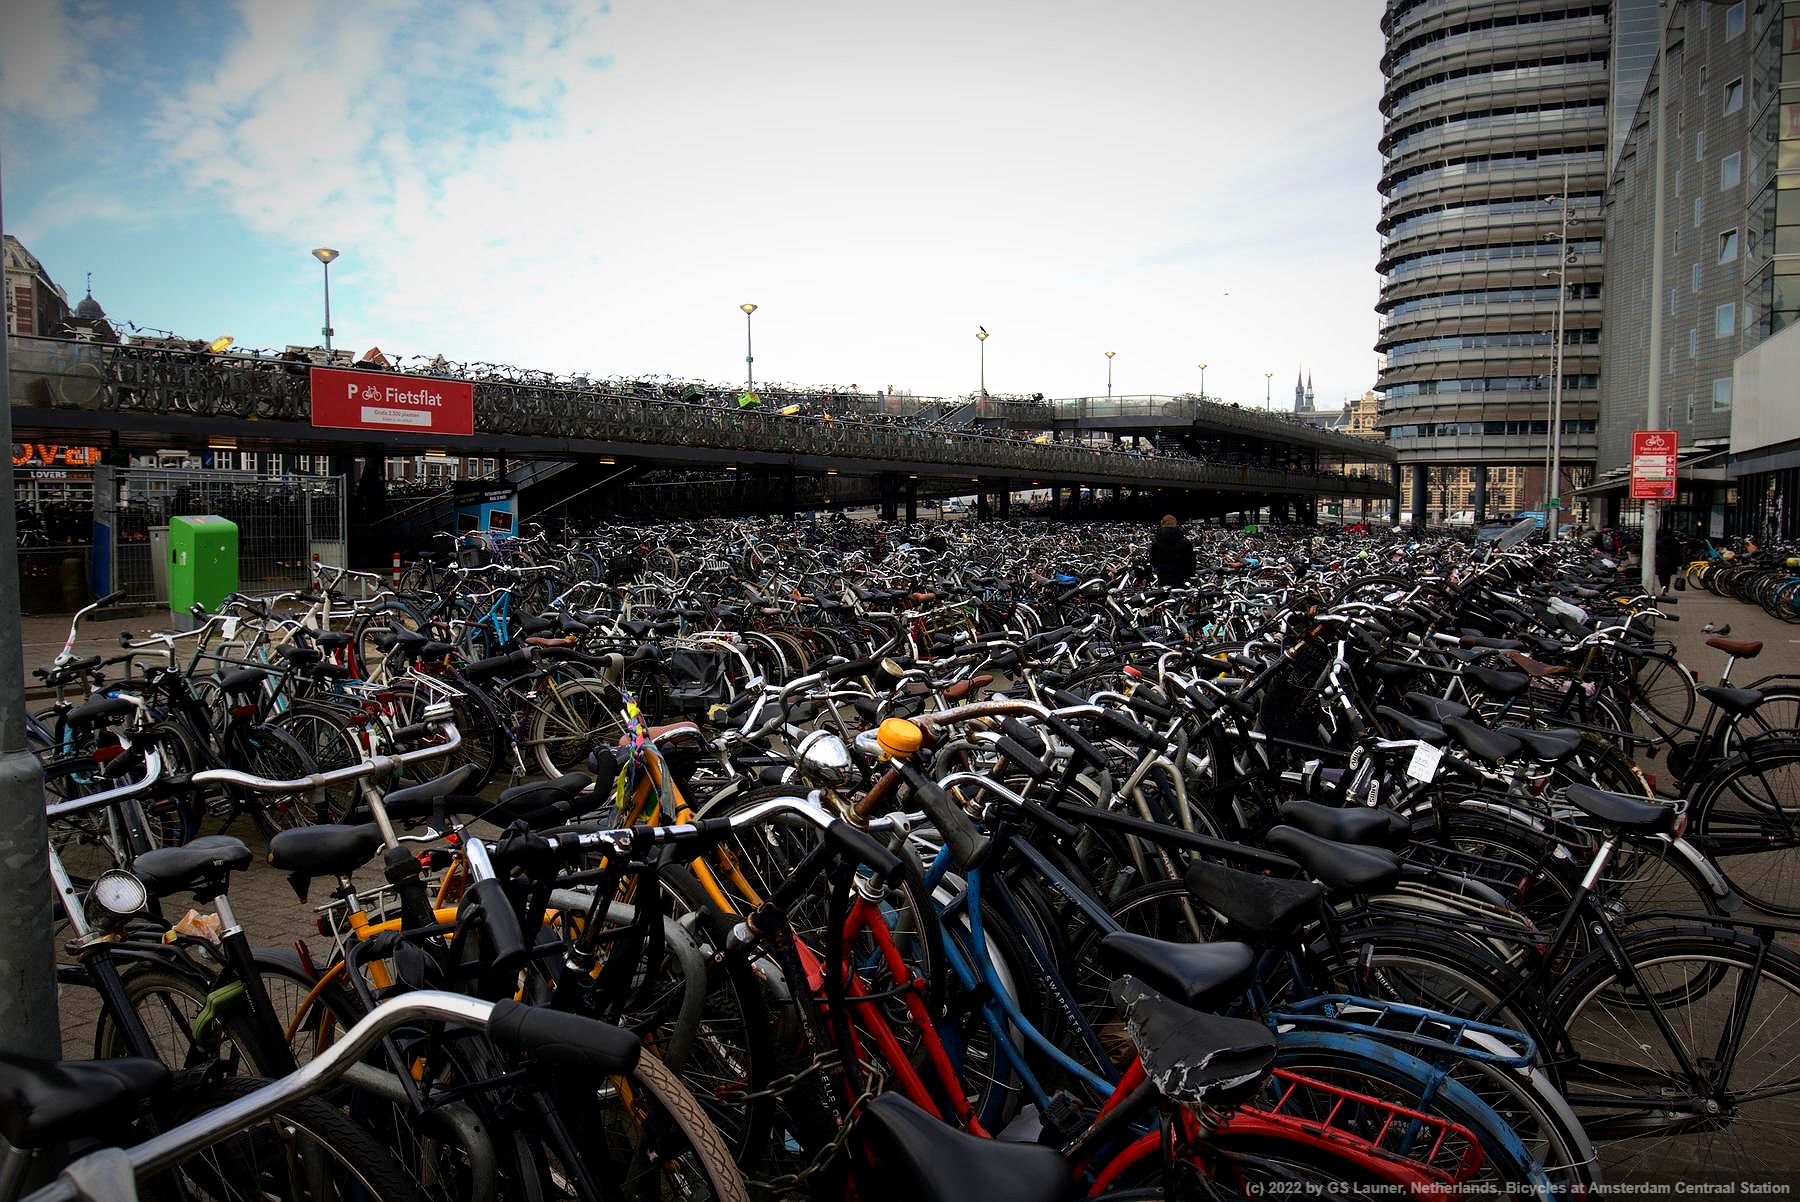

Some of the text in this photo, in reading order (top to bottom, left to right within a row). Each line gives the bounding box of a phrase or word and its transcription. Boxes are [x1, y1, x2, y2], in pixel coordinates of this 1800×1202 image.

[347, 383, 443, 407] P Fietsflat
[30, 471, 67, 479] LOVERS
[1044, 975, 1083, 1033] SWAPFIETS
